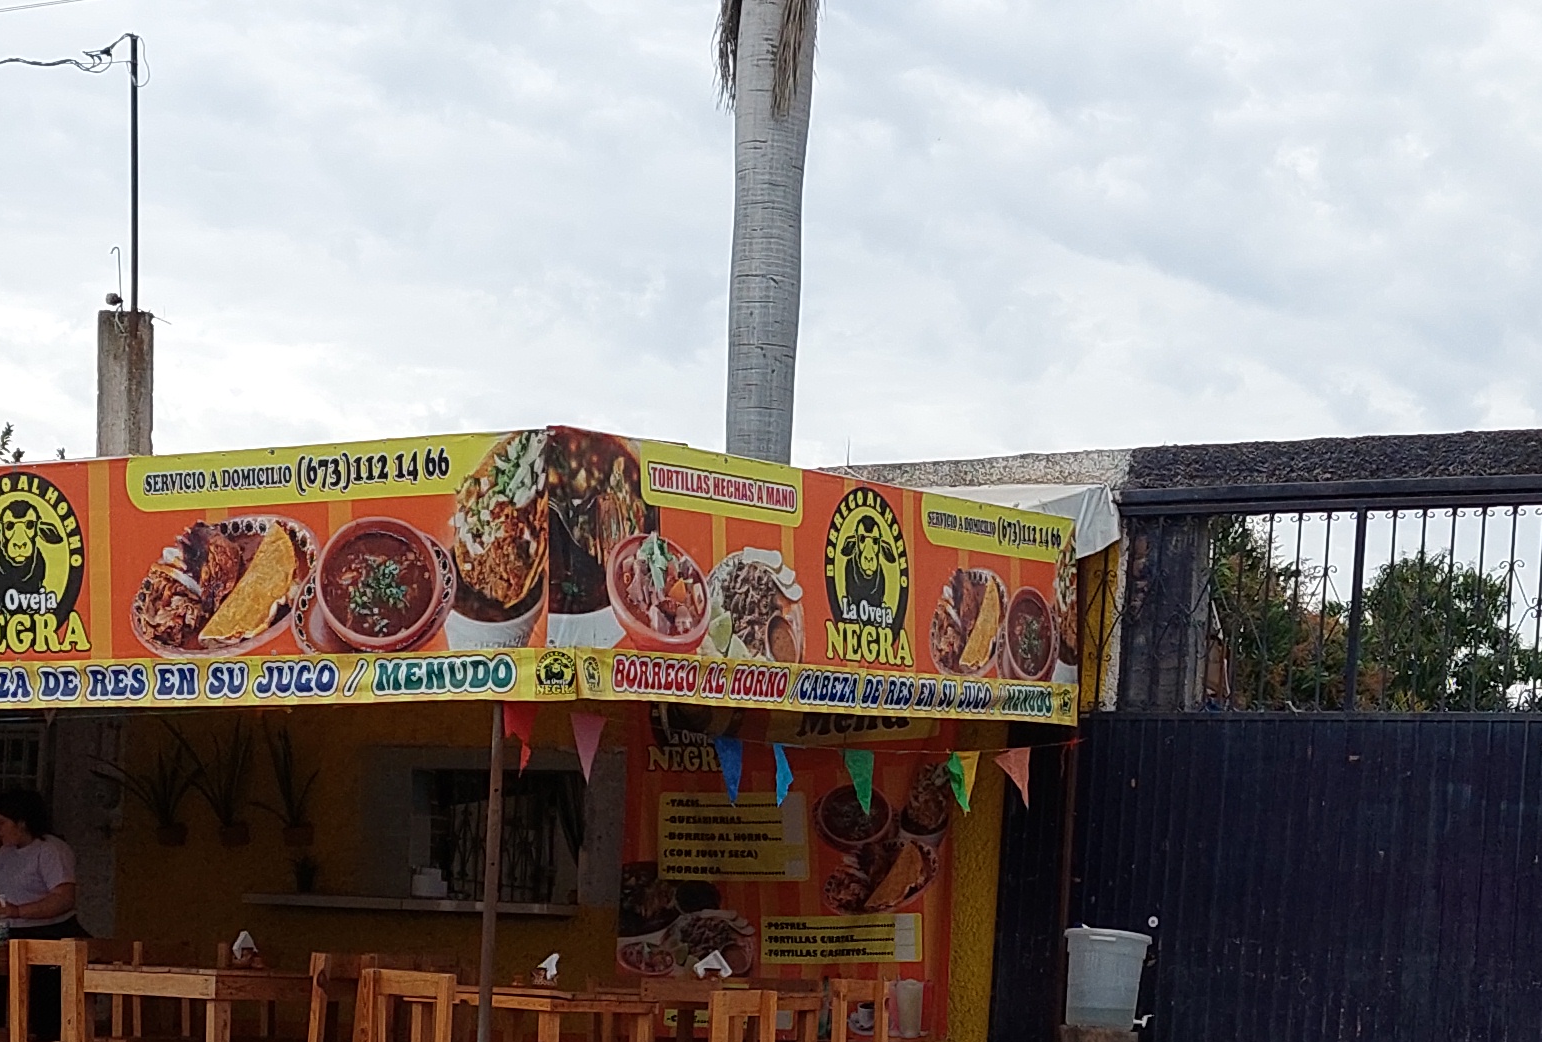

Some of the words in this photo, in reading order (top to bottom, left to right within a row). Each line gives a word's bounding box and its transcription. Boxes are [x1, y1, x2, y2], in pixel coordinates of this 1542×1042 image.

[16, 474, 40, 495] AL
[144, 471, 206, 496] SERVICIO
[208, 473, 218, 491] A
[221, 464, 292, 489] DOMICILIO
[394, 450, 419, 484] 14
[423, 446, 451, 480] 66
[651, 466, 710, 495] TORTILLAS
[713, 477, 754, 501] HECHAS
[757, 484, 764, 502] A
[766, 486, 795, 509] MANO
[5, 587, 58, 615] Oveja
[841, 597, 857, 618] La
[859, 602, 893, 624] Oveja
[825, 620, 914, 666] NEGRA
[38, 666, 81, 701] DE
[87, 664, 148, 699] RES
[154, 663, 200, 698] EN
[207, 662, 249, 698] SU
[256, 660, 340, 697] JUGO
[373, 654, 517, 696] MENUDO
[613, 655, 700, 695] BORREGO
[701, 661, 727, 697] AL
[730, 664, 790, 703] HORNO
[862, 675, 884, 708] DE
[884, 676, 914, 710] RES
[913, 679, 938, 711] EN
[936, 680, 958, 712] SU
[957, 681, 993, 713] JUGO
[1001, 684, 1055, 717] MENUDO
[647, 745, 723, 773] NEGR
[717, 832, 732, 842] AL
